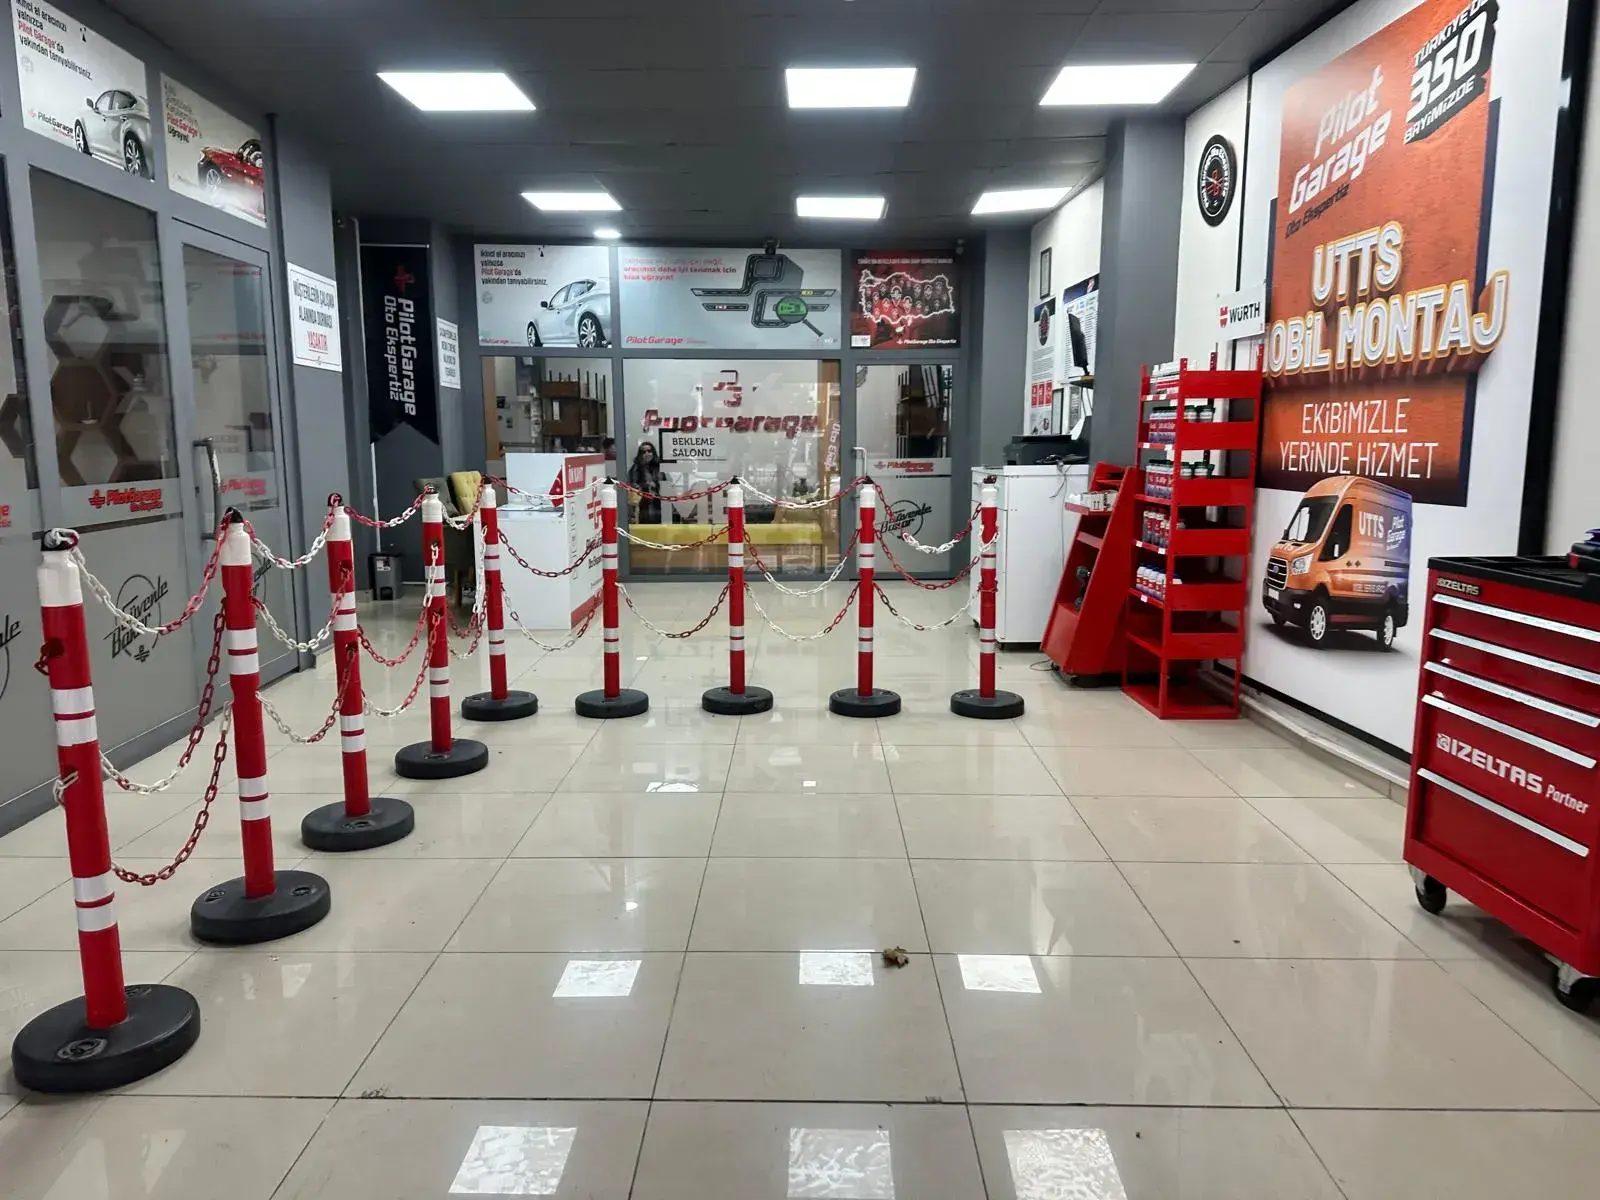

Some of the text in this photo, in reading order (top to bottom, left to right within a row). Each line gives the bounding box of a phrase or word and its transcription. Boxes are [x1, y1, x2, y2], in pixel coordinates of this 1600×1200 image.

[17, 8, 44, 31] yalnızca
[18, 20, 34, 37] Pilot
[20, 34, 49, 57] yakından
[1405, 10, 1488, 123] 350
[1314, 64, 1384, 160] Pilot
[1288, 110, 1392, 215] Garage
[481, 268, 494, 276] Pilot
[722, 265, 737, 274] için
[1311, 221, 1404, 306] UTTS
[1229, 302, 1261, 324] WÜRTH
[1334, 269, 1510, 369] MONTAJ
[384, 295, 400, 401] Oto Ekspertiz
[625, 336, 684, 346] PilotGarage
[398, 297, 417, 416] PilotGarage
[1302, 398, 1411, 434] EKİBİMİZLE
[672, 437, 716, 446] BEKLEME
[672, 448, 713, 457] SALONU
[1280, 441, 1439, 479] YERİNDE HİZMET
[1358, 510, 1385, 539] UTTS
[1545, 783, 1590, 815] Partner
